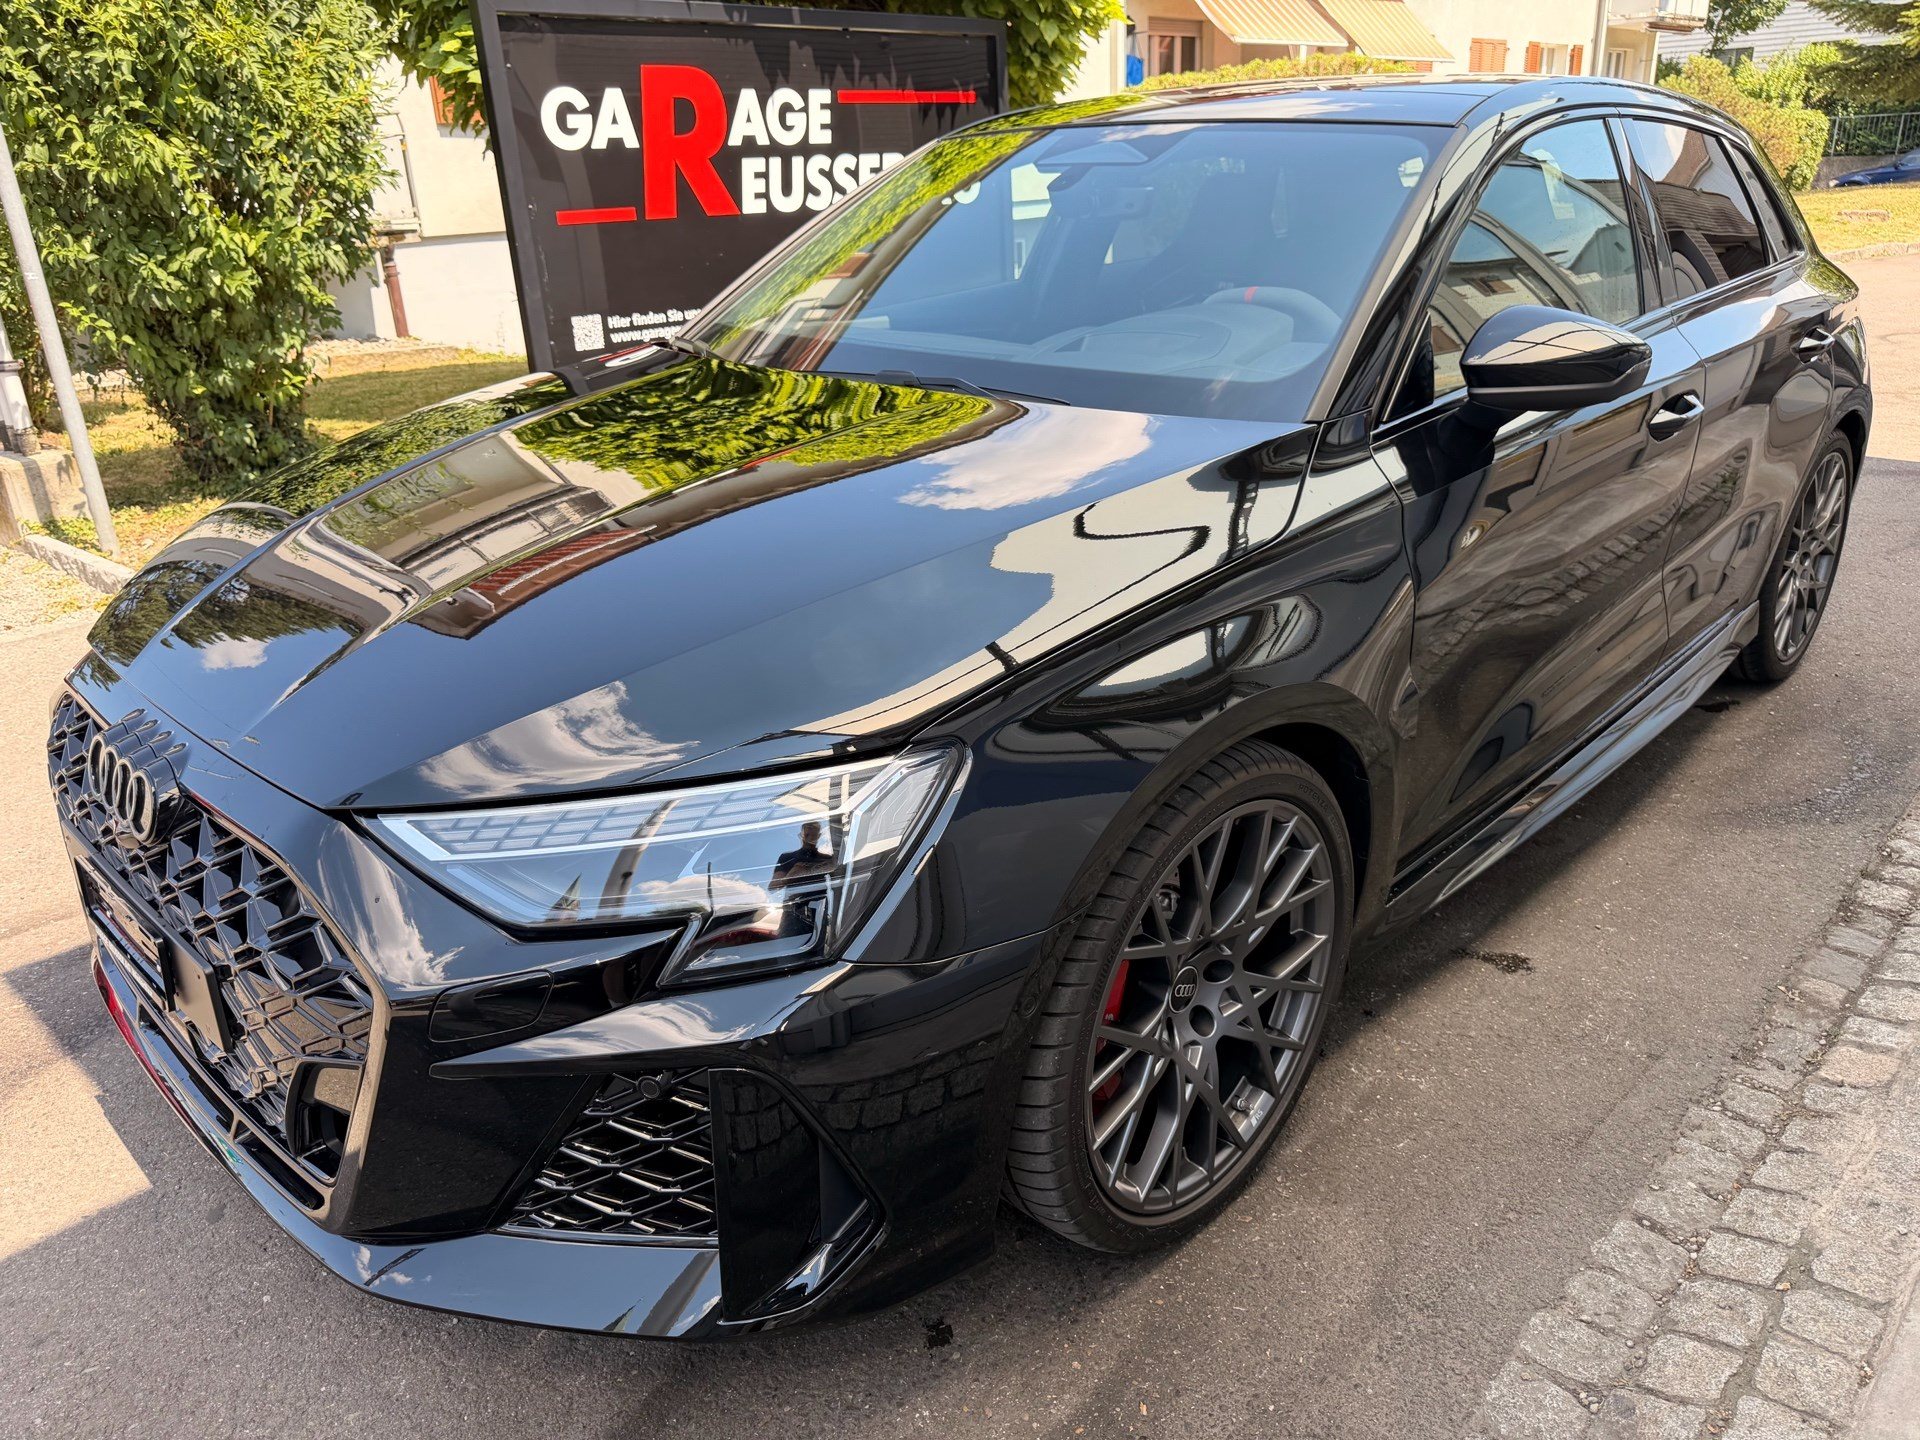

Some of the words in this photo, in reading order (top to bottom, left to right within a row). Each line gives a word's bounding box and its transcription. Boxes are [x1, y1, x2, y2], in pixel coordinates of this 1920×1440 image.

[540, 64, 832, 220] GARAGE
[607, 315, 631, 329] Hier
[632, 310, 667, 326] finden
[667, 308, 684, 322] Sie
